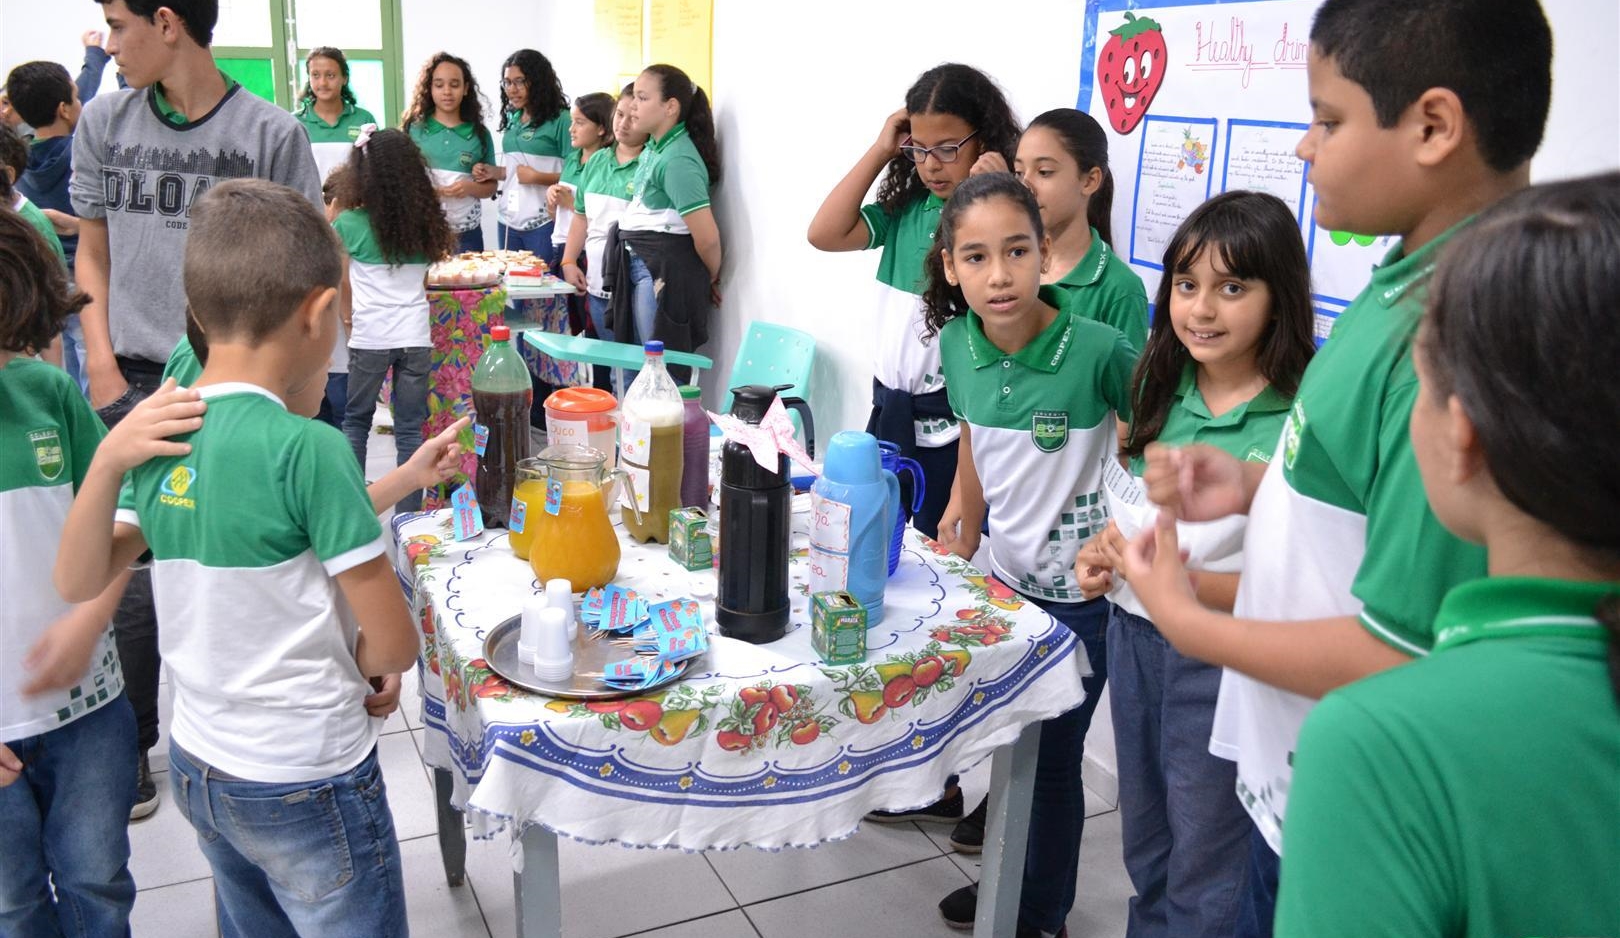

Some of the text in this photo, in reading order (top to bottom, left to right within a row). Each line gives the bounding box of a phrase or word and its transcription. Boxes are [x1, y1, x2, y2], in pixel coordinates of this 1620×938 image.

[1196, 16, 1309, 89] Healthy drin
[166, 220, 188, 230] CODE
[1050, 325, 1072, 366] COOPEX
